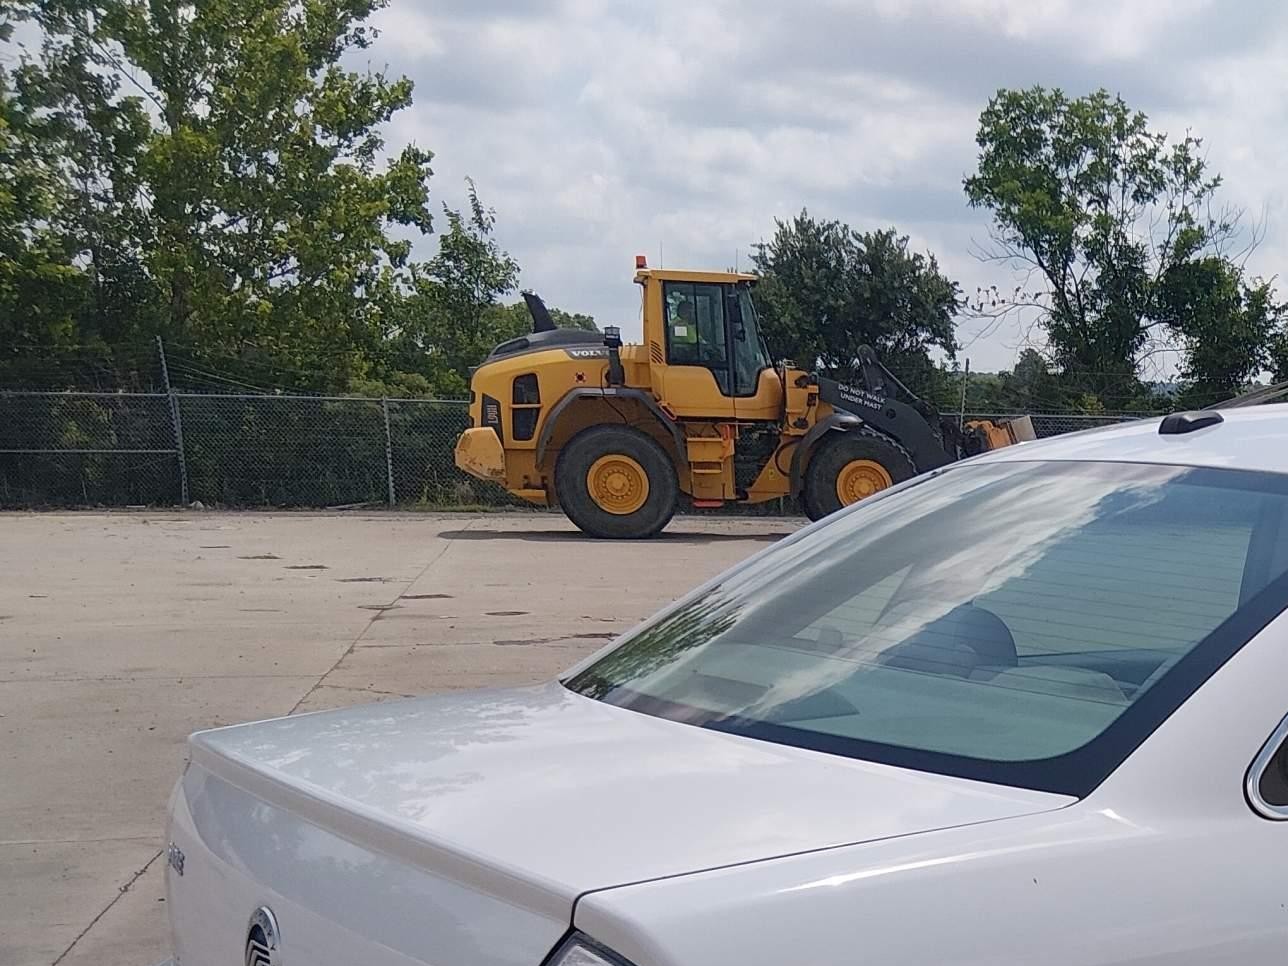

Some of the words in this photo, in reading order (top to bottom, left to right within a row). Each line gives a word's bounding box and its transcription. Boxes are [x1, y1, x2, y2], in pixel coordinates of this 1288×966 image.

[838, 384, 849, 392] DO
[850, 388, 865, 397] NOT
[866, 392, 886, 404] WALK
[840, 393, 863, 405] UNDER
[864, 401, 882, 411] MAST
